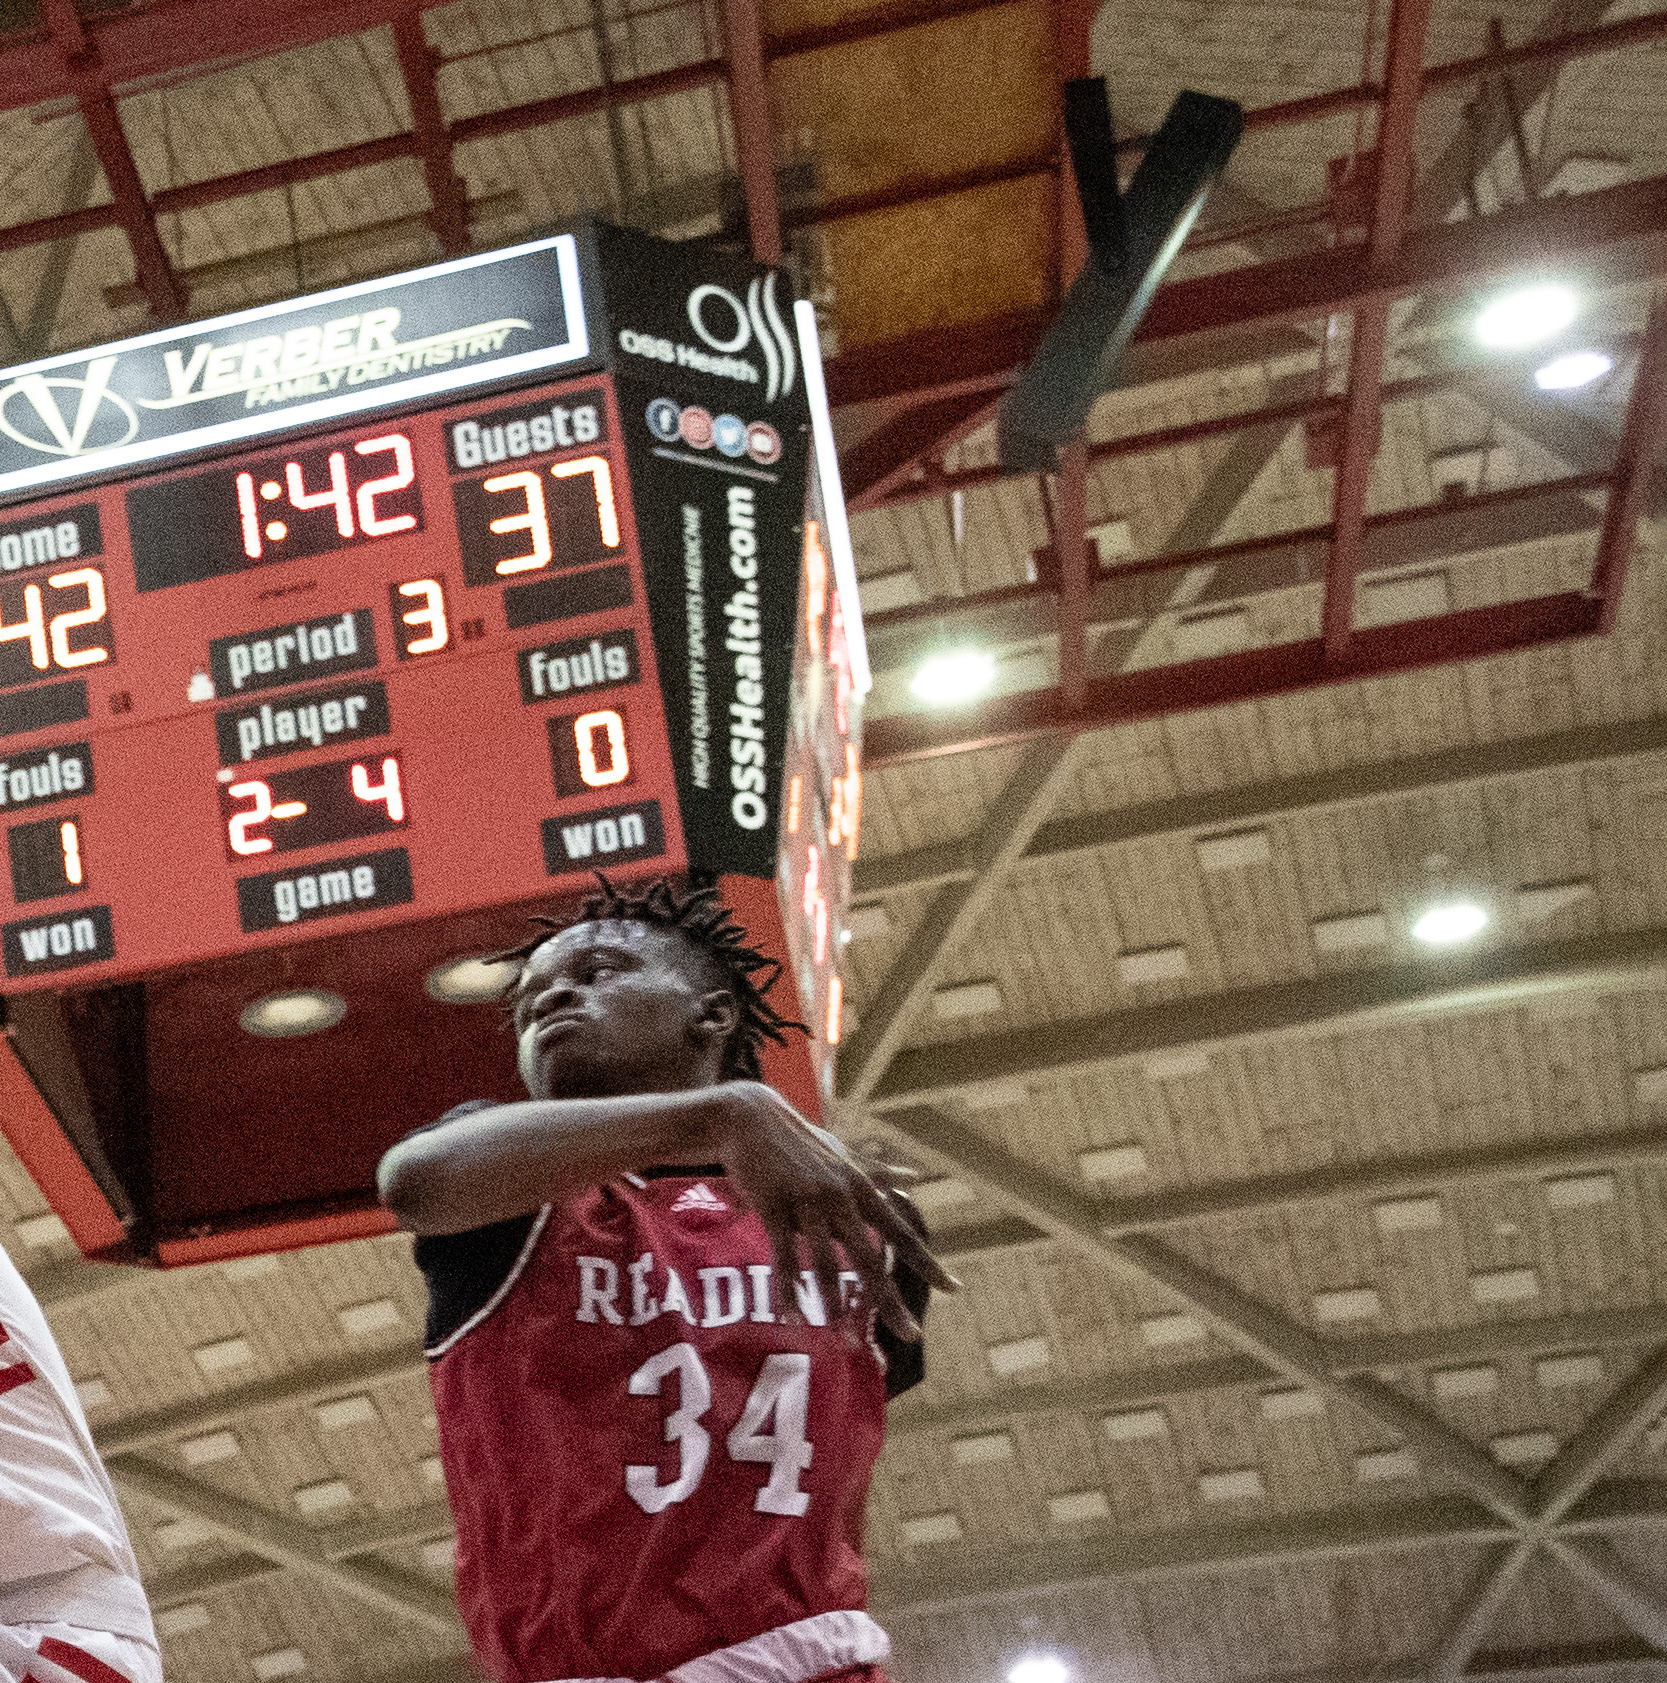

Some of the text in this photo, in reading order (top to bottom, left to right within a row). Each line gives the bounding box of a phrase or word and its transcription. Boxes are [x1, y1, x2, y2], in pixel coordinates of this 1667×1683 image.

[165, 307, 402, 398] VERBER
[243, 329, 509, 409] FAMILY DENTISTRY
[453, 404, 601, 468] Guests
[237, 433, 418, 559] 1:42
[483, 454, 621, 576] 37
[227, 577, 450, 690] period 3
[529, 640, 629, 695] fouls
[723, 485, 767, 830] OSSHealth.com
[239, 694, 367, 761] player
[574, 709, 629, 788] 0
[59, 820, 83, 886] 1
[562, 813, 646, 862] won
[273, 863, 377, 924] game
[20, 915, 97, 960] won
[625, 1342, 814, 1517] 34
